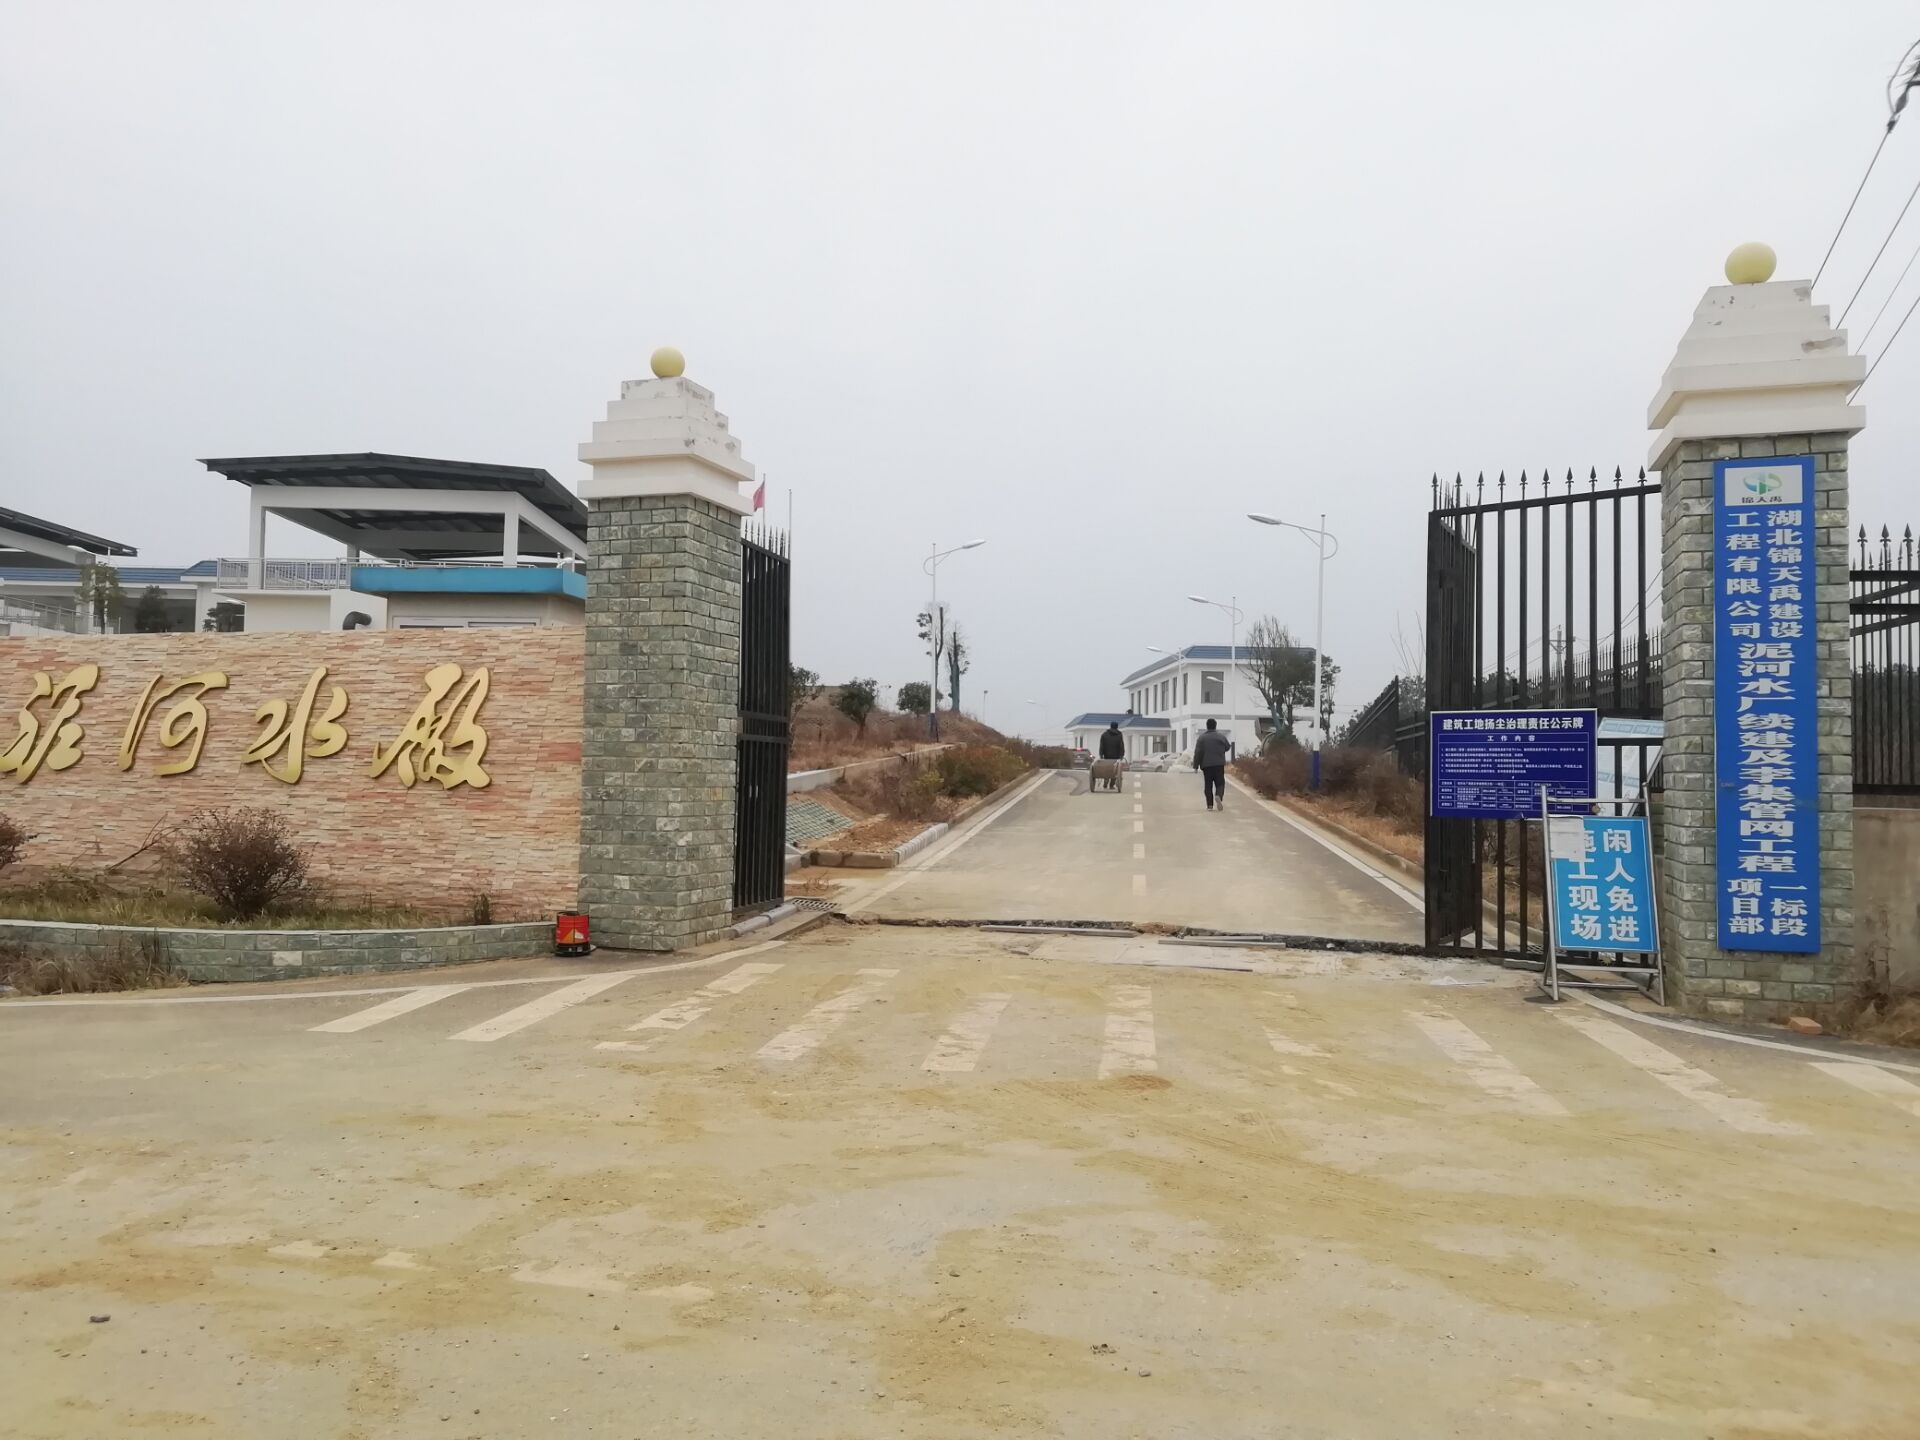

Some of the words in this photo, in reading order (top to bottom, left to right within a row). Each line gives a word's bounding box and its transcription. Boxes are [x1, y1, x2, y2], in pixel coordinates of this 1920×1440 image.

[1725, 512, 1762, 639] 工程有限公司
[1766, 510, 1804, 639] 湖北锦天禹建设
[1442, 717, 1584, 730] 建筑工地扬尘治理责任公示牌
[1737, 642, 1797, 874] 泥河水厂续建及李集管网工程
[1602, 828, 1640, 943] 闲人免进
[1727, 877, 1765, 936] 项目部
[1768, 884, 1809, 937] 一标段
